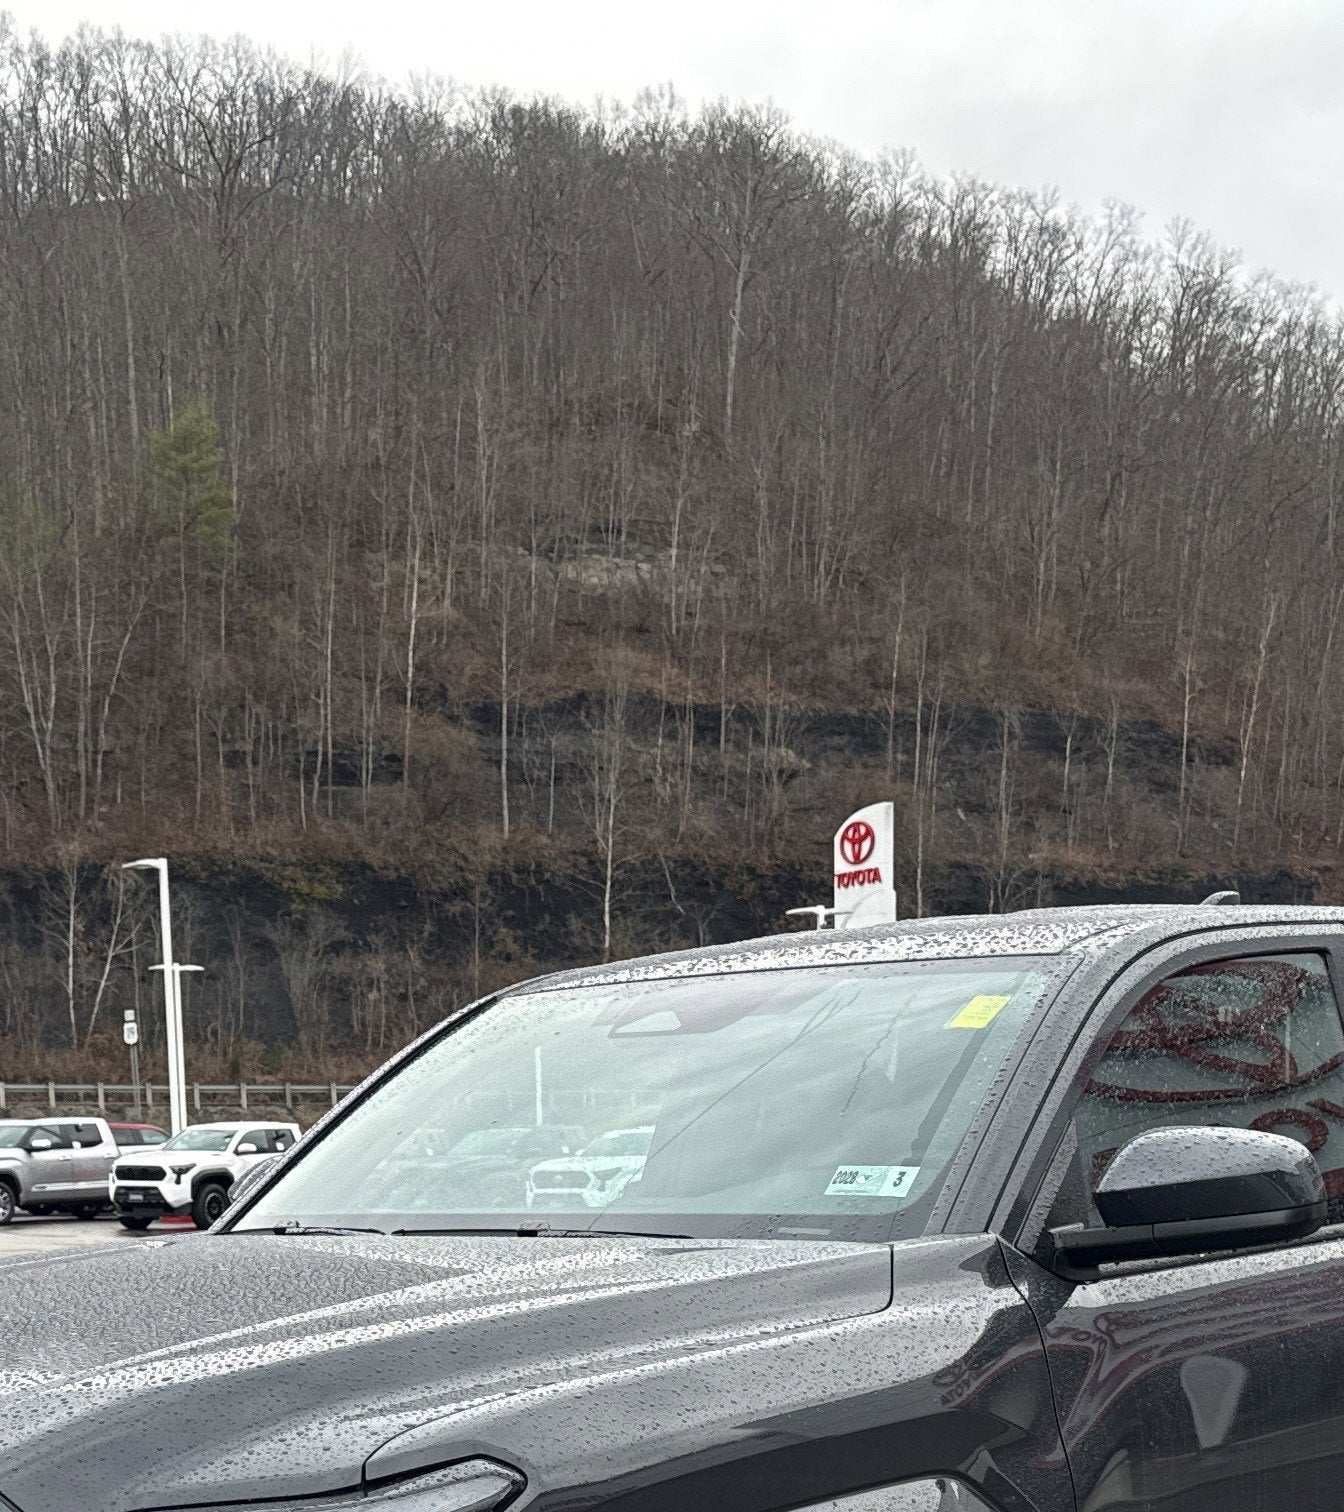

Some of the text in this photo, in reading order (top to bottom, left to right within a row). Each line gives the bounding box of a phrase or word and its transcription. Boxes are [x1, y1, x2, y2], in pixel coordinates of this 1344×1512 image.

[834, 867, 882, 889] TOYOTA
[831, 1170, 907, 1188] 2028 3
